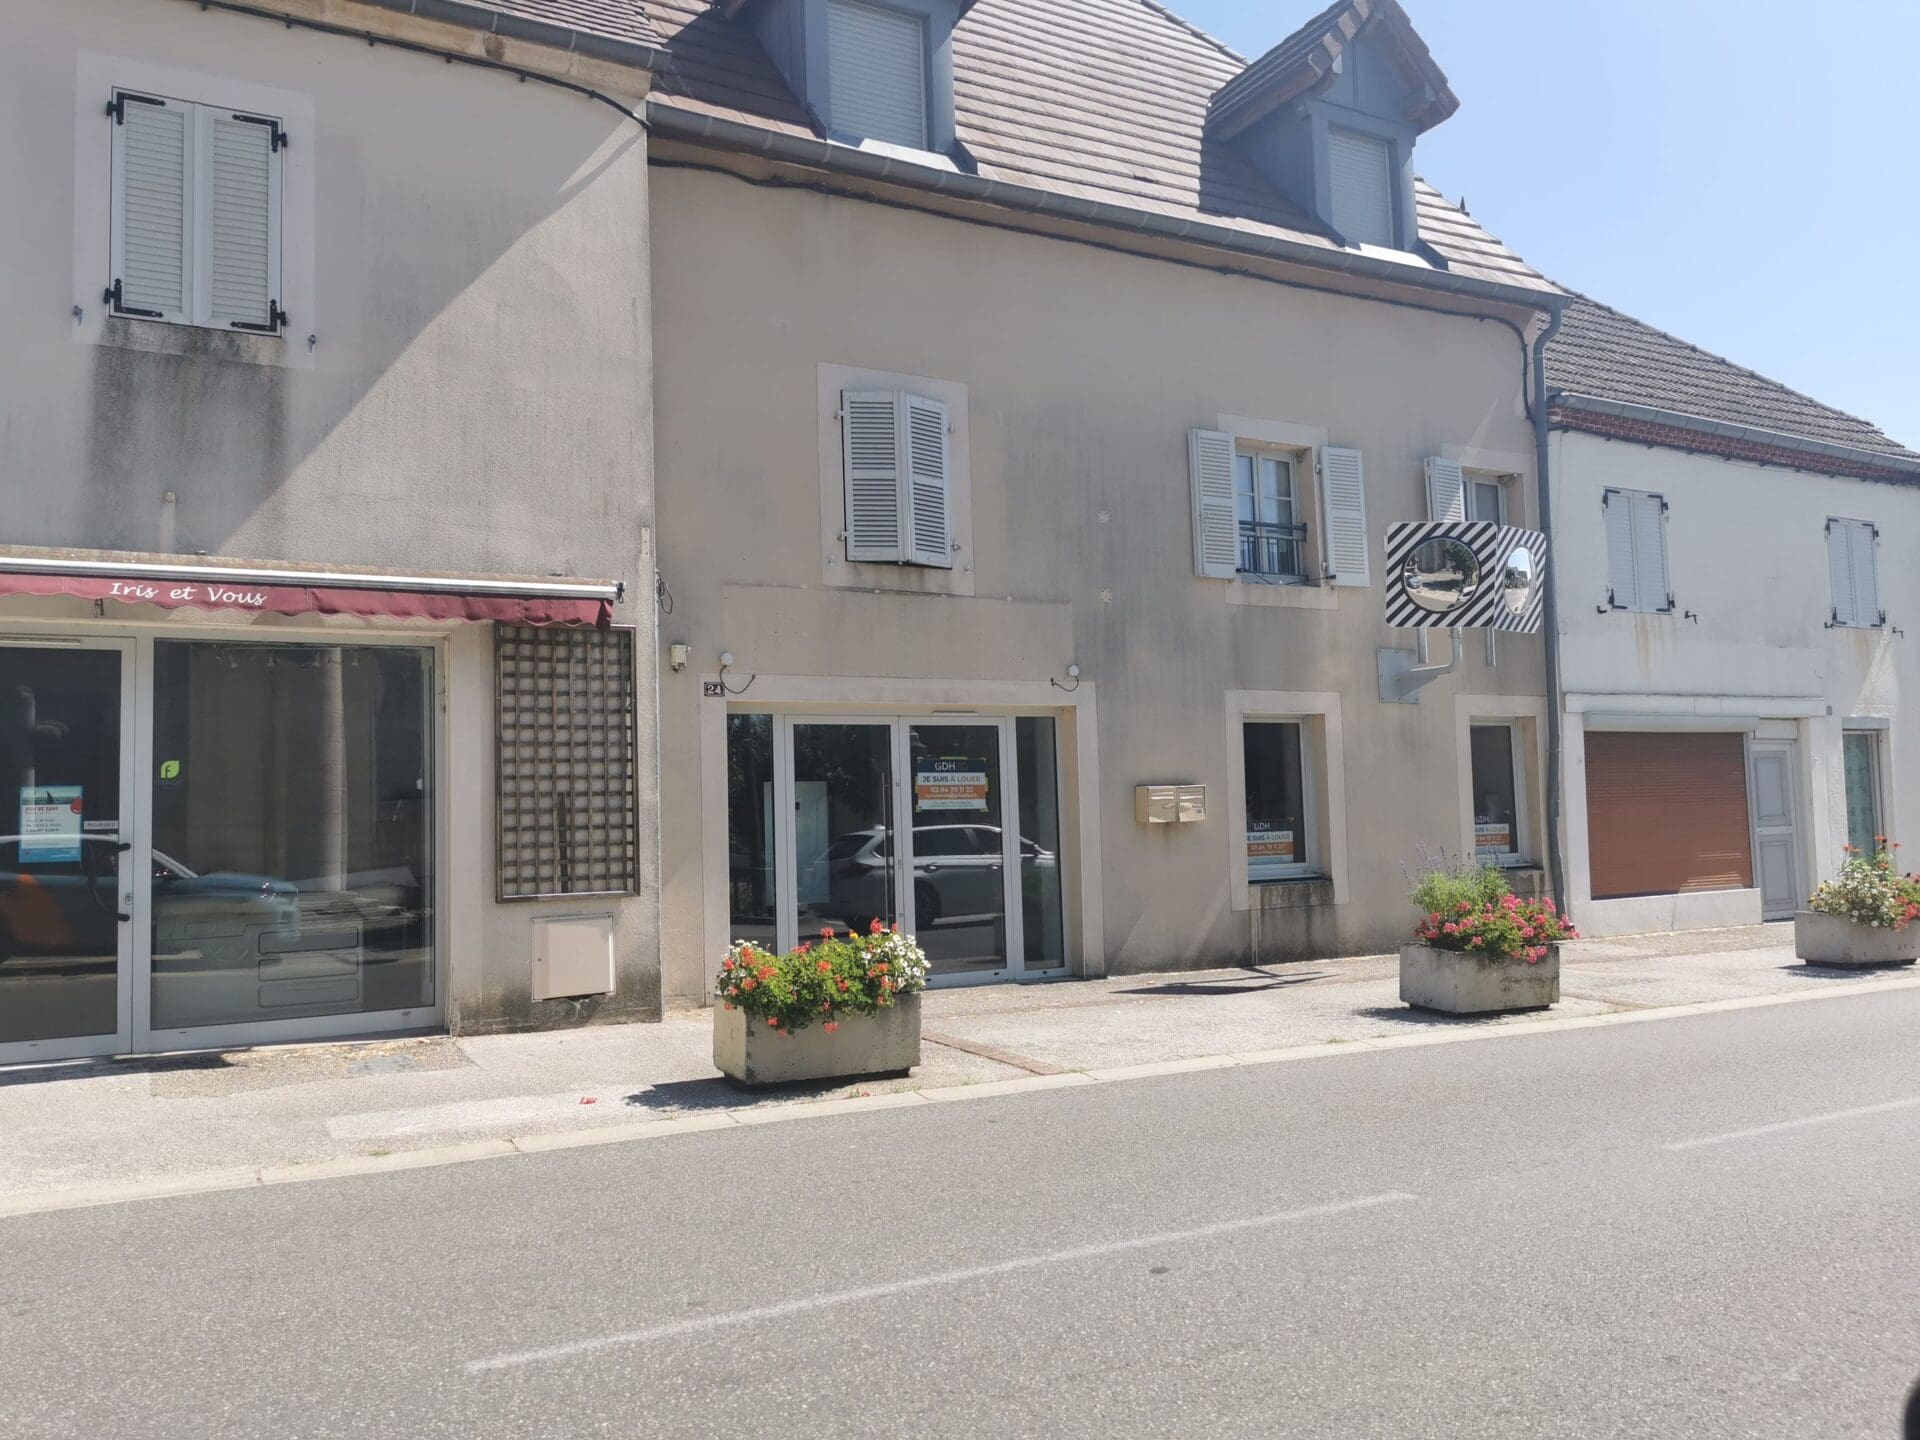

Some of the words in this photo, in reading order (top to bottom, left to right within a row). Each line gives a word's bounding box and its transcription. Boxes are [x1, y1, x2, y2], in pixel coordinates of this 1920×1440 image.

[110, 582, 159, 599] Iris
[170, 586, 197, 600] et
[207, 587, 268, 606] Vous
[707, 684, 721, 694] 24
[934, 761, 956, 771] GDH
[922, 775, 931, 783] JE
[932, 775, 949, 783] SUIS
[957, 775, 981, 783] LOUER
[1253, 822, 1271, 830] GDH
